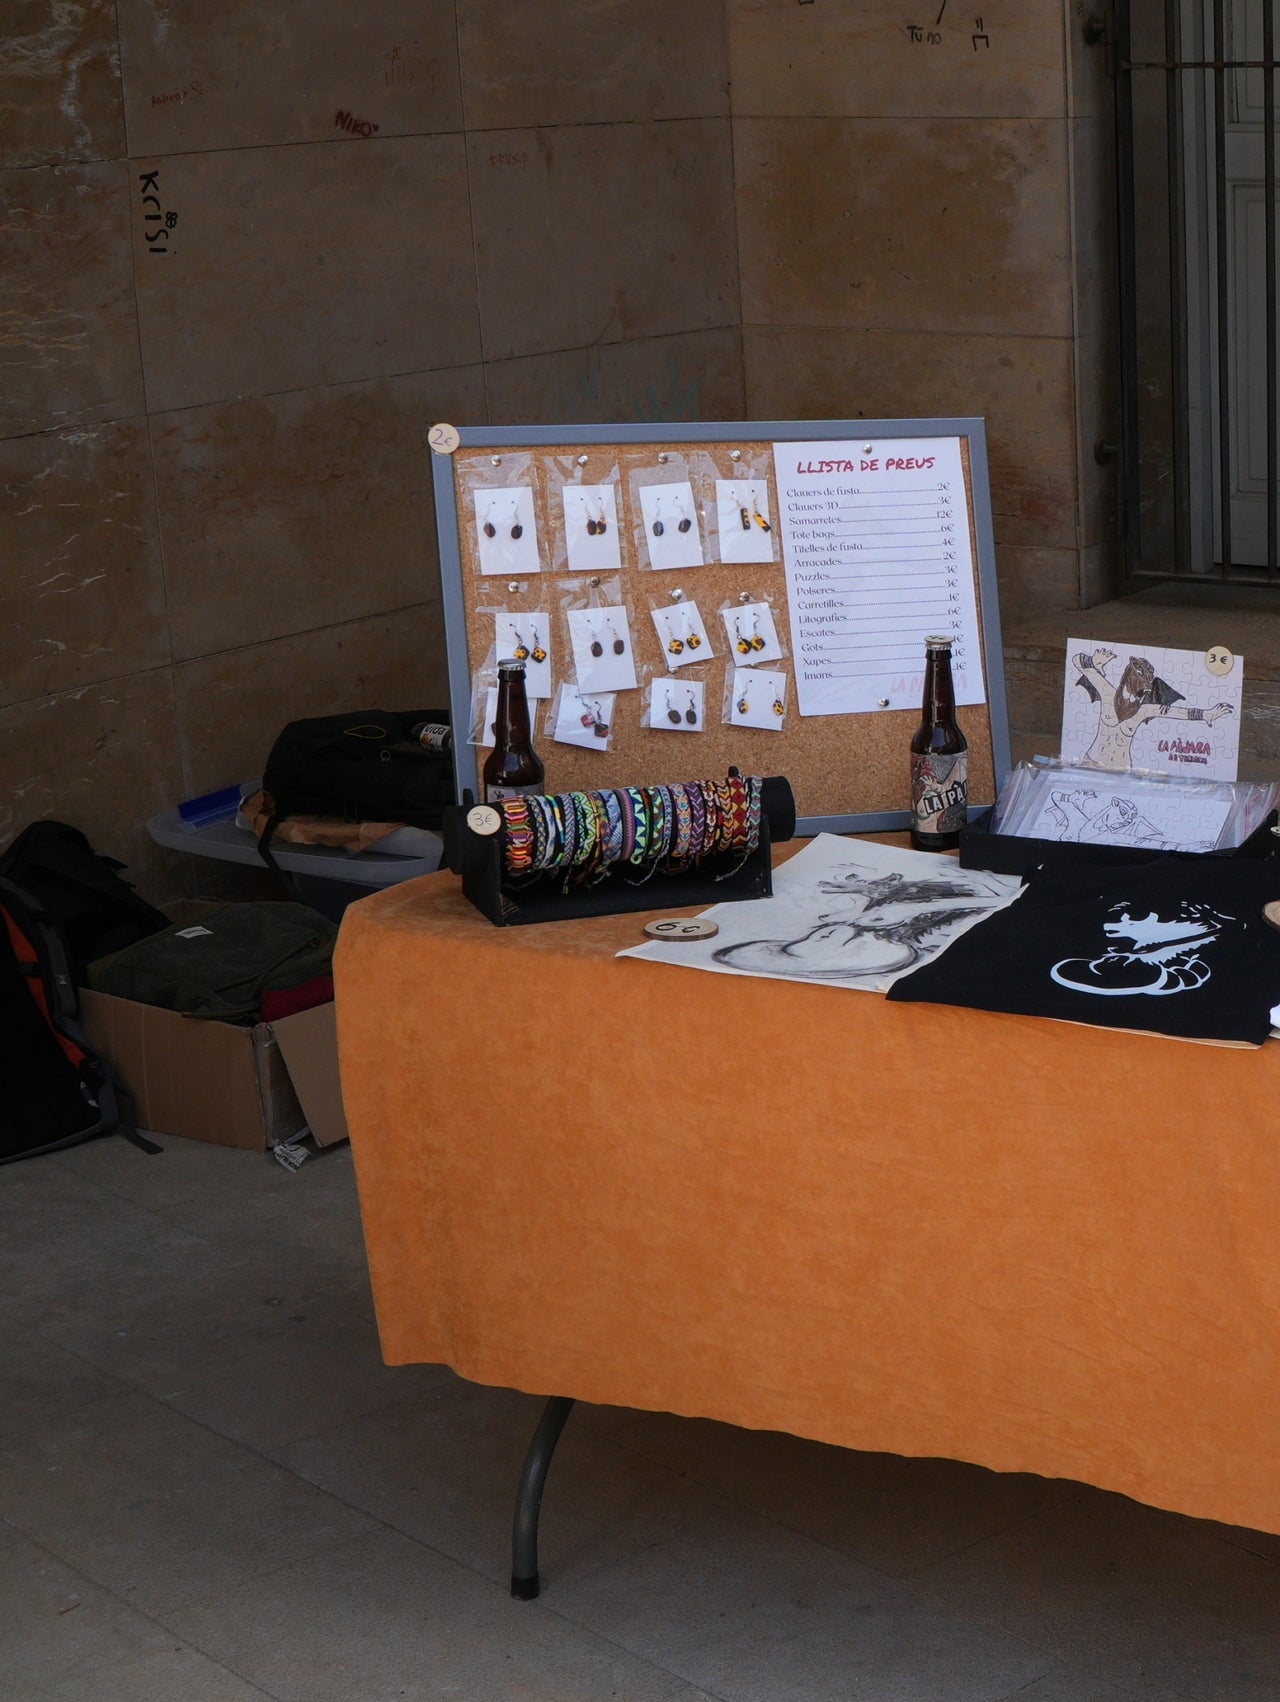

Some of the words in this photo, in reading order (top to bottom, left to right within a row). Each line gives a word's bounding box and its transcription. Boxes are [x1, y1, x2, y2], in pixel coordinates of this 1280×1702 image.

[796, 459, 854, 474] LLISTA
[860, 458, 880, 471] DE
[885, 456, 936, 471] PREUS
[786, 488, 822, 497] Clauers
[823, 487, 835, 496] de
[837, 486, 860, 496] fusta
[937, 482, 950, 491] 2€
[787, 502, 823, 511] Clauers
[824, 501, 839, 510] 3D
[938, 496, 952, 505] 3€
[789, 517, 842, 526] Samarretes
[936, 510, 953, 519] 12€
[790, 530, 811, 540] Tote
[812, 530, 835, 540] bags
[940, 524, 954, 532] 6€
[792, 544, 825, 554] Titelles
[826, 543, 838, 552] de
[839, 541, 863, 551] fusta
[941, 537, 955, 546] 4€
[794, 557, 842, 568] Arracades
[943, 551, 956, 560] 2€
[795, 572, 831, 582] Puzzles
[944, 565, 958, 574] 3€
[796, 586, 836, 595] Polseres
[945, 579, 958, 588] 3€
[798, 599, 844, 610] Carretilles
[949, 593, 959, 602] 1€
[798, 612, 847, 624] Litografies
[947, 607, 961, 615] 6€
[949, 620, 962, 629] 3€
[801, 643, 824, 652] Gots
[953, 634, 964, 643] 1€
[803, 656, 832, 667] Xapes
[955, 648, 965, 657] 1€
[804, 671, 833, 680] Imans
[956, 662, 966, 670] 1€
[473, 812, 493, 826] 3€
